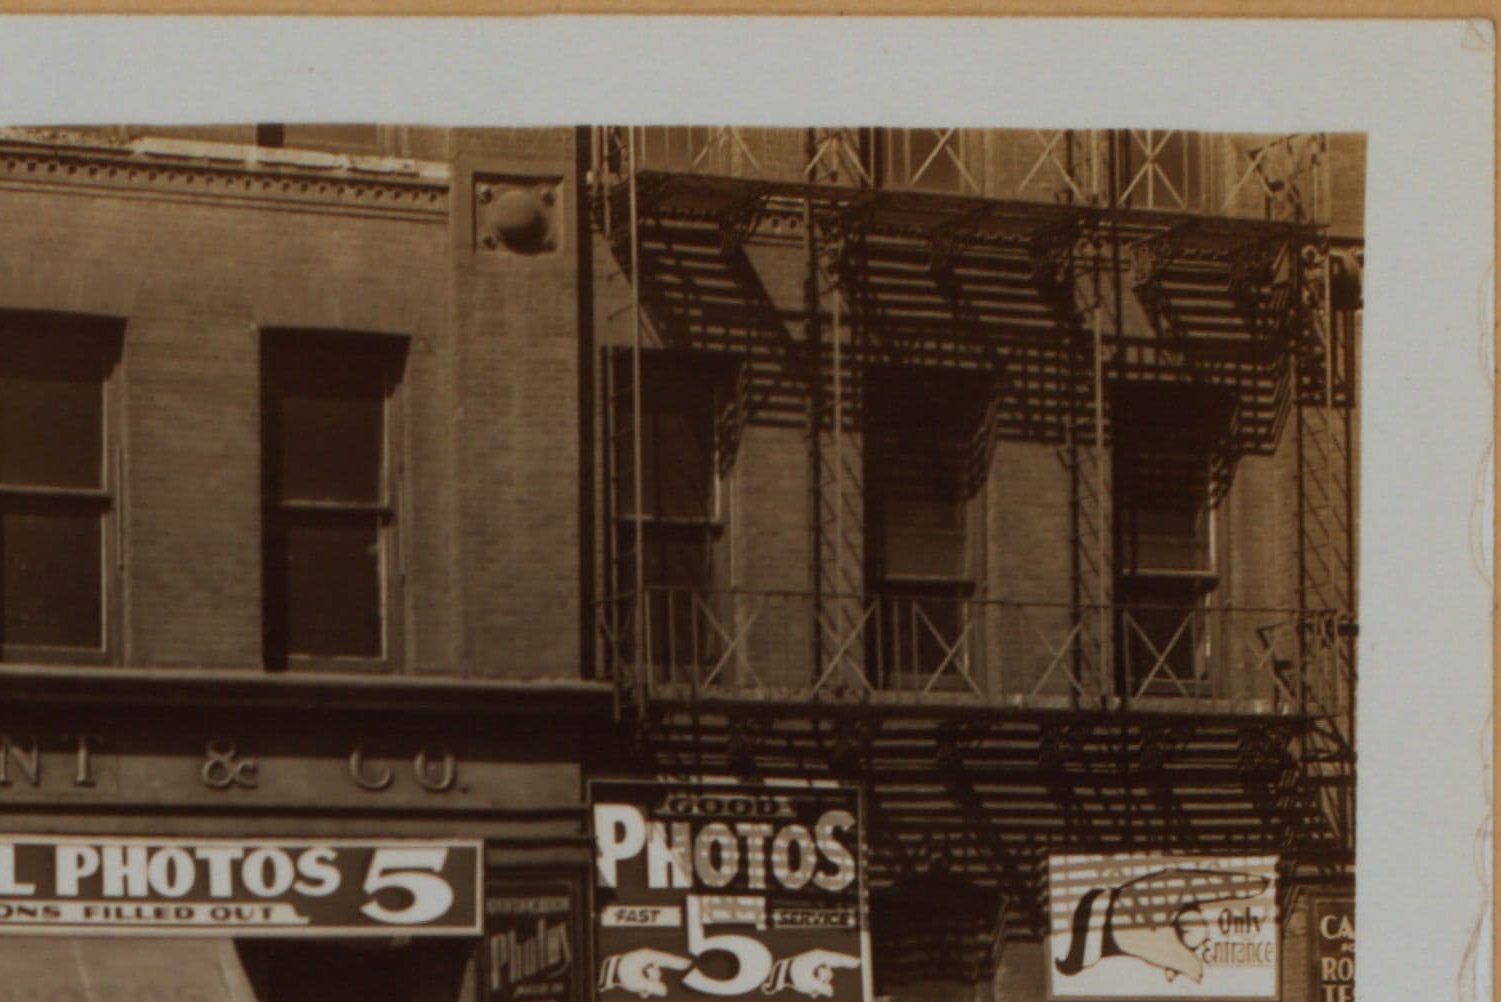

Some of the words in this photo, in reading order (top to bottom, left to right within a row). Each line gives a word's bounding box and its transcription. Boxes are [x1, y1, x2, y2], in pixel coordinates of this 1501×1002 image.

[201, 739, 259, 790] &
[594, 803, 856, 891] PHOTOS
[55, 845, 342, 898] PHOTOS
[359, 849, 454, 925] 5
[84, 906, 195, 921] FILLED
[211, 906, 274, 921] OUT
[614, 909, 660, 923] FAST
[780, 911, 851, 925] SERVICE
[683, 894, 773, 996] 5
